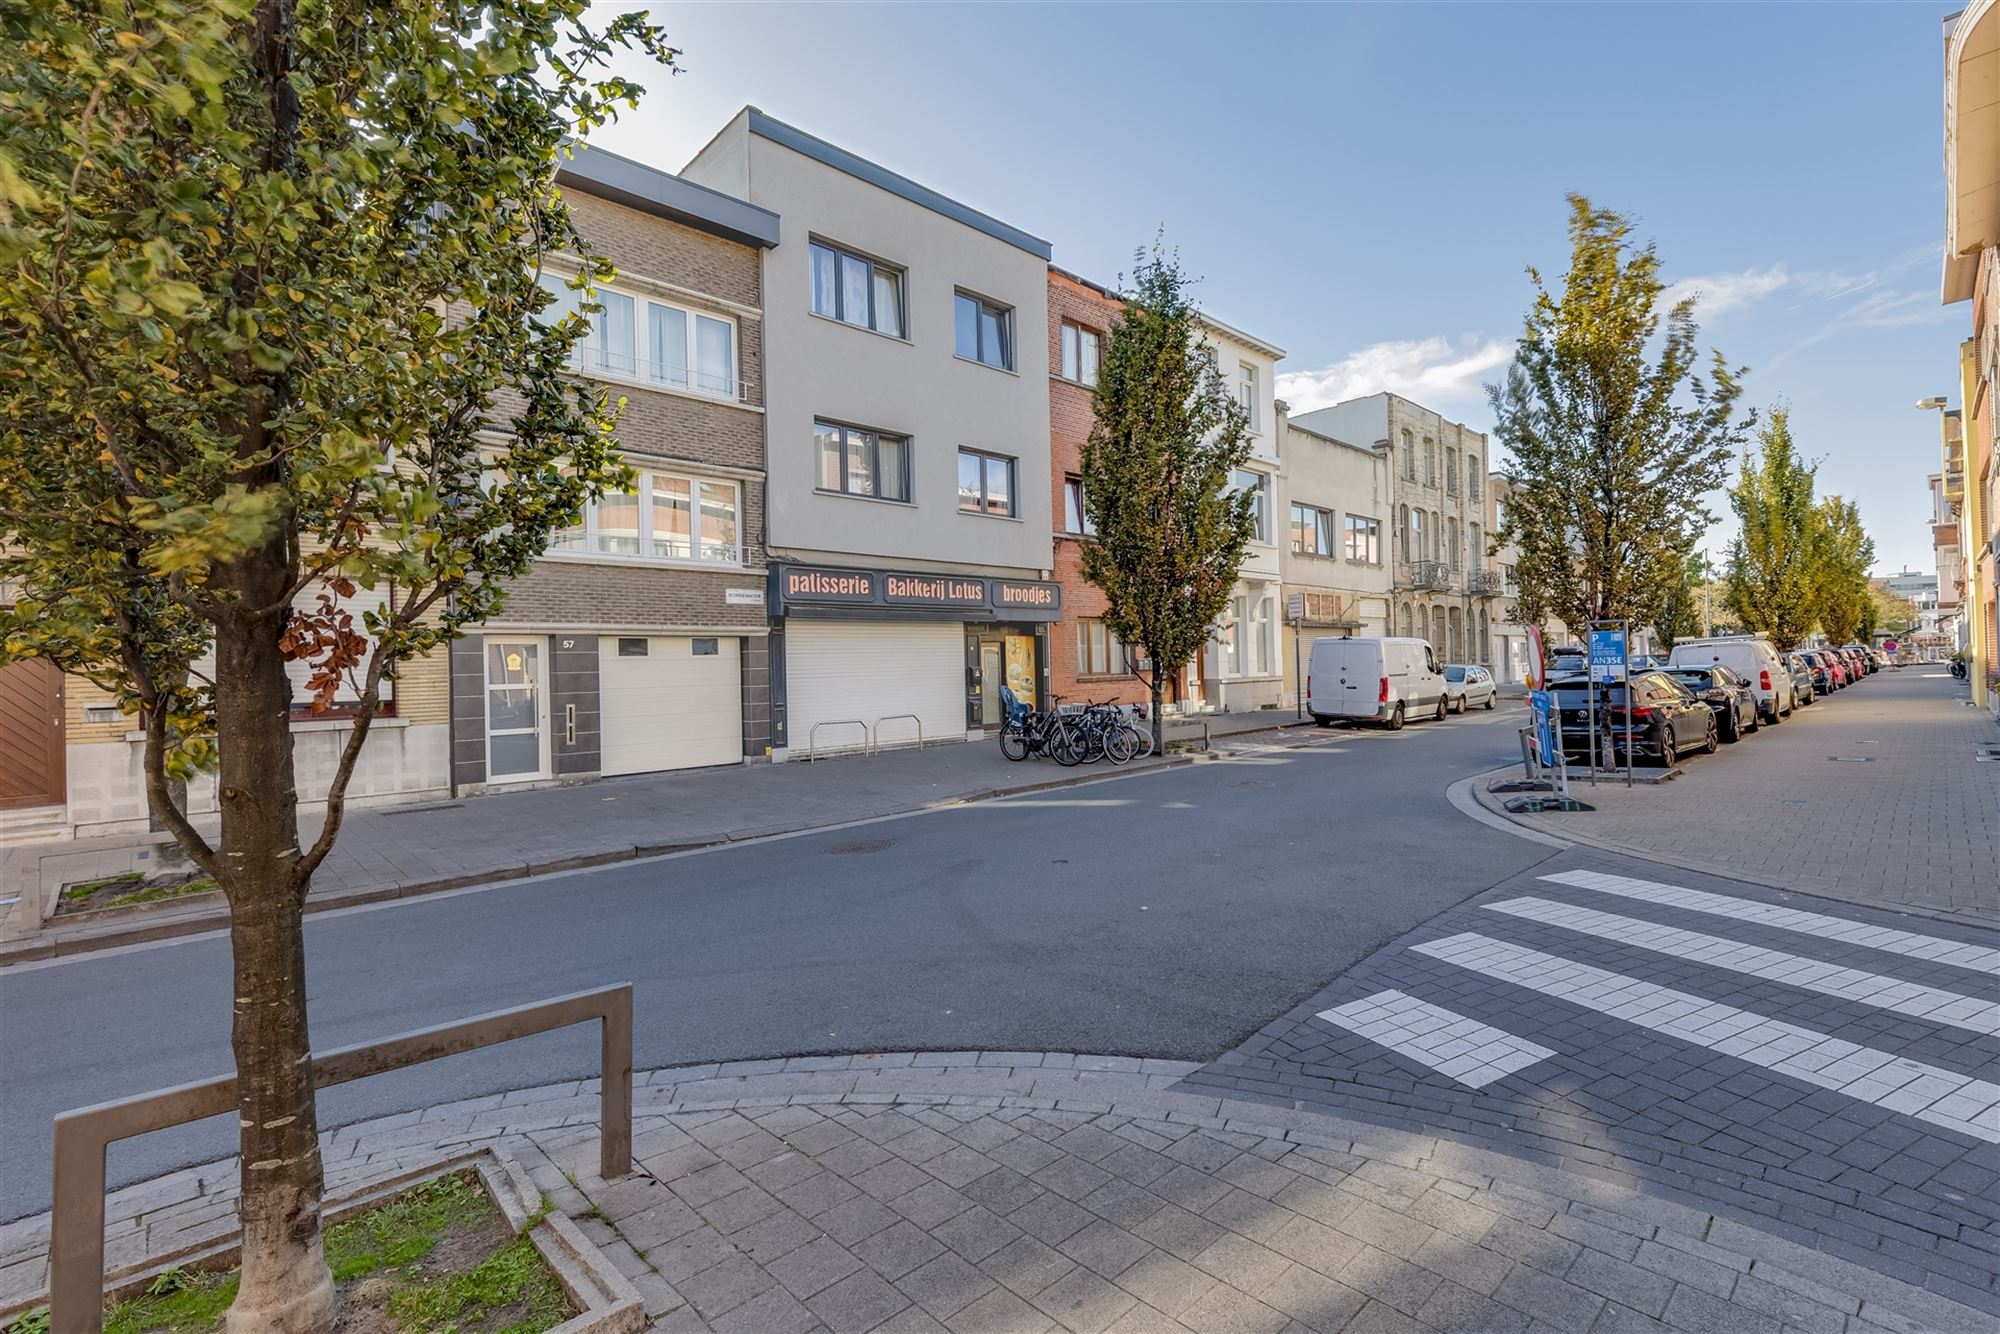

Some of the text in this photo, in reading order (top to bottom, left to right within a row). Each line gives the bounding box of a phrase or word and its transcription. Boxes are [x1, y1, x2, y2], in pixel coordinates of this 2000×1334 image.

[789, 573, 869, 594] patisserie
[888, 577, 982, 600] Bakkerij Lotus
[1003, 585, 1052, 604] broodjes
[563, 640, 574, 648] 57
[1592, 634, 1599, 642] P
